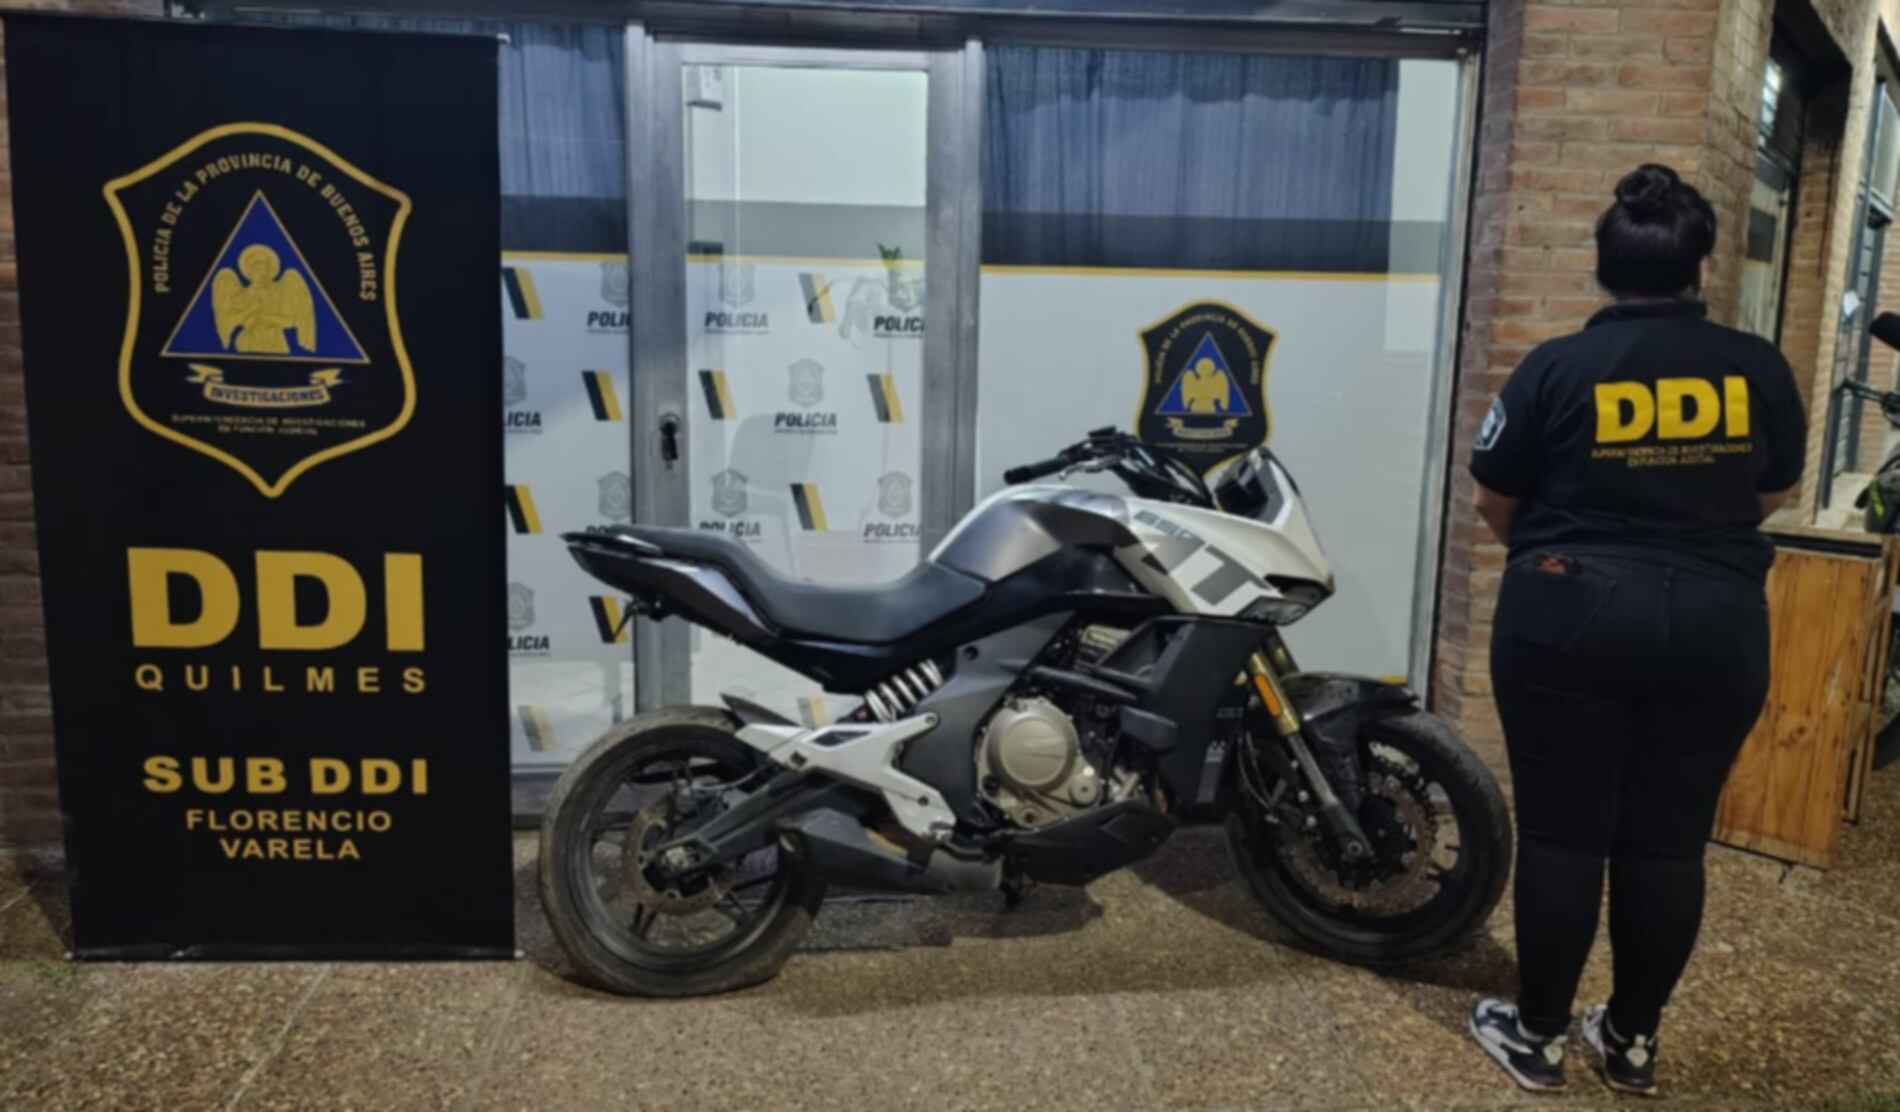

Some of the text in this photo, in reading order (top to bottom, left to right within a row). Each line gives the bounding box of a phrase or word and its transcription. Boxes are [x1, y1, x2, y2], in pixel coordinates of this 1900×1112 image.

[153, 152, 377, 301] POLICIA DE LA PROVINCIA DE BUENOS AIRES
[704, 311, 769, 328] POLICIA
[505, 411, 542, 428] ICIA
[774, 411, 838, 428] POLICIA
[1594, 375, 1749, 443] DDI
[127, 547, 425, 652] DDI
[135, 663, 426, 693] QUILMES
[143, 756, 428, 795] SUB DDI
[186, 809, 392, 832] FLORENCIO
[219, 837, 361, 860] VARELA
